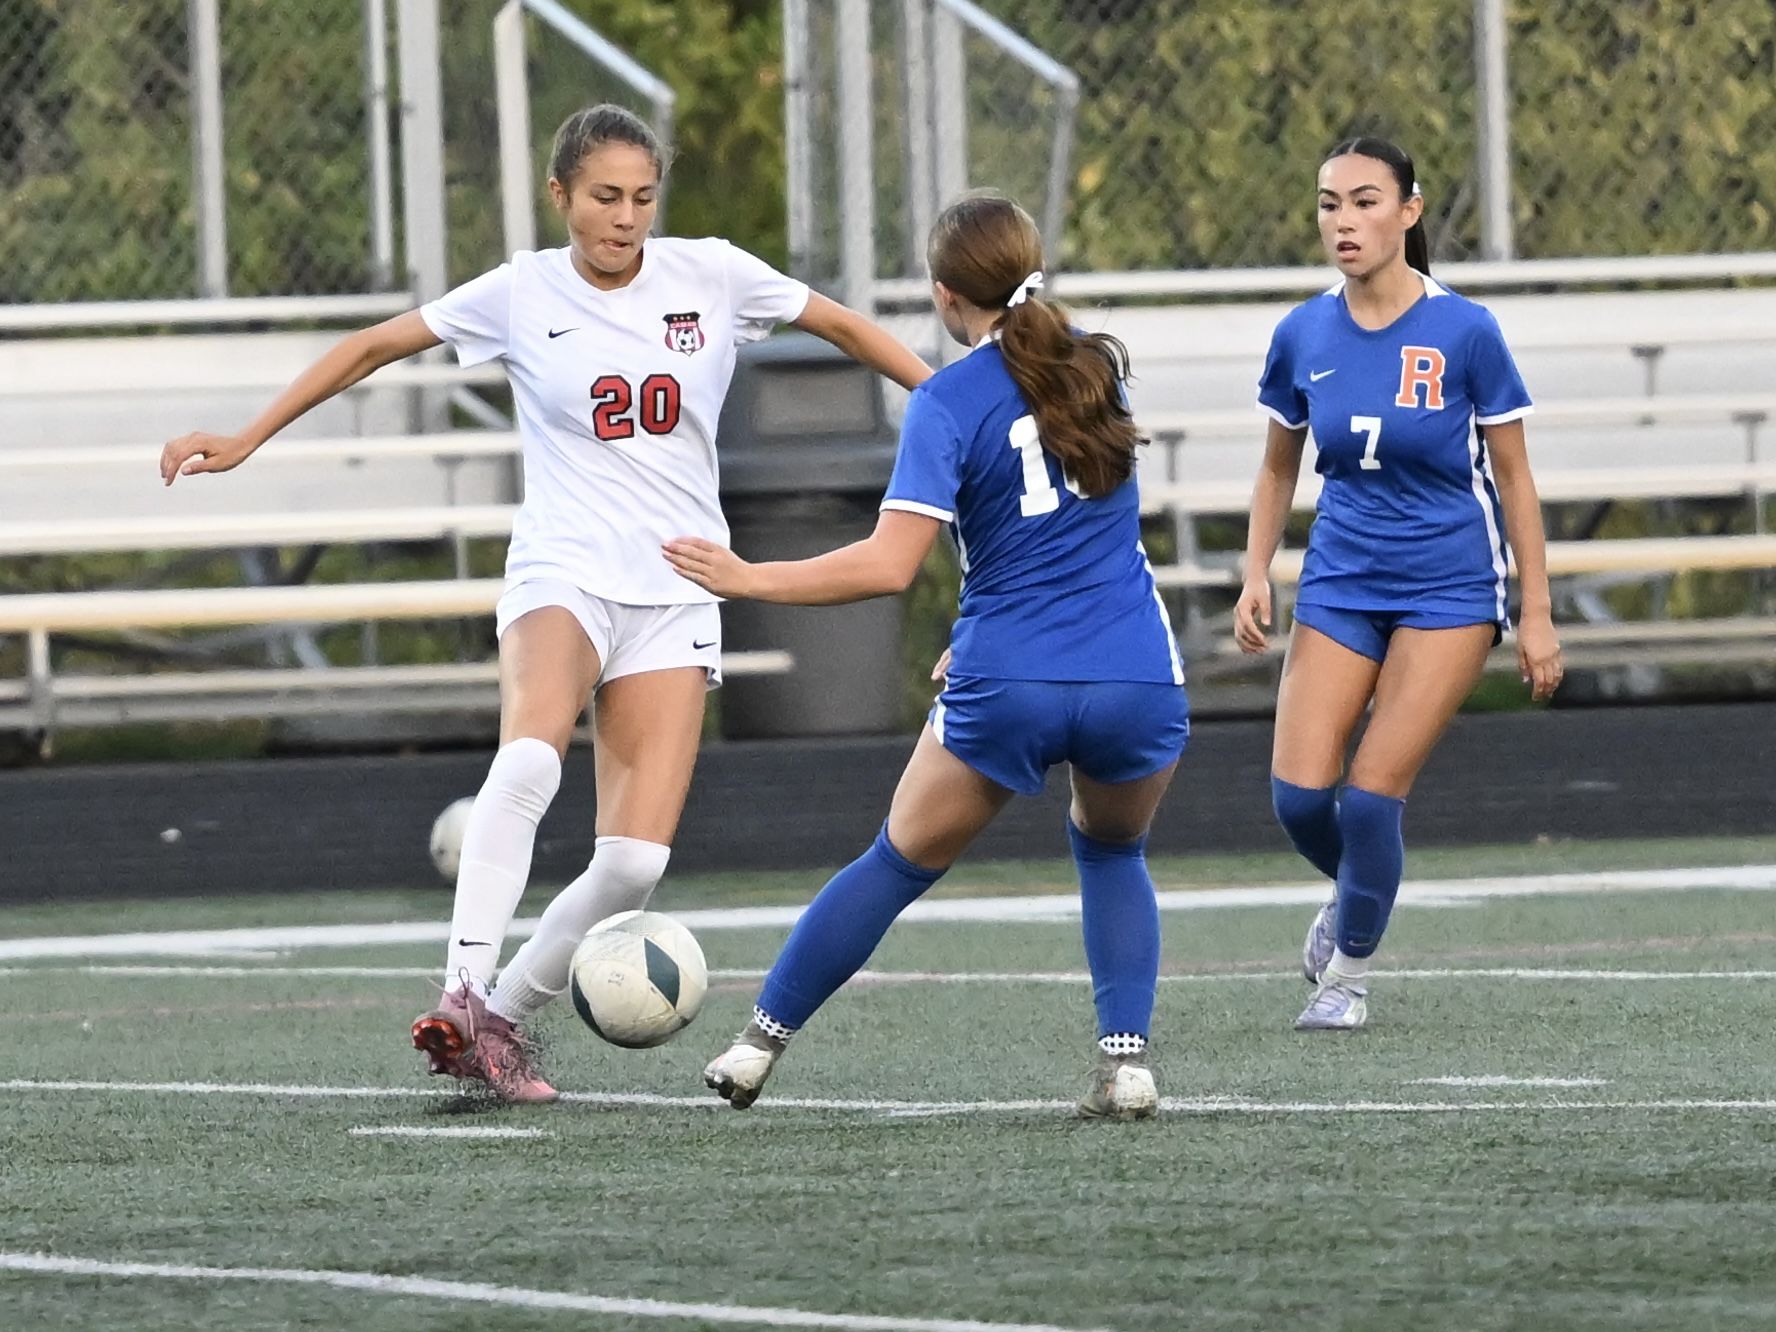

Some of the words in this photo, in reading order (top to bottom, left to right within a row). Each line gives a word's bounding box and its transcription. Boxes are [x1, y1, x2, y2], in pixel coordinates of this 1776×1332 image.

[590, 373, 681, 441] 20
[1395, 345, 1446, 410] R
[1008, 413, 1092, 517] 1
[1350, 415, 1382, 470] 7
